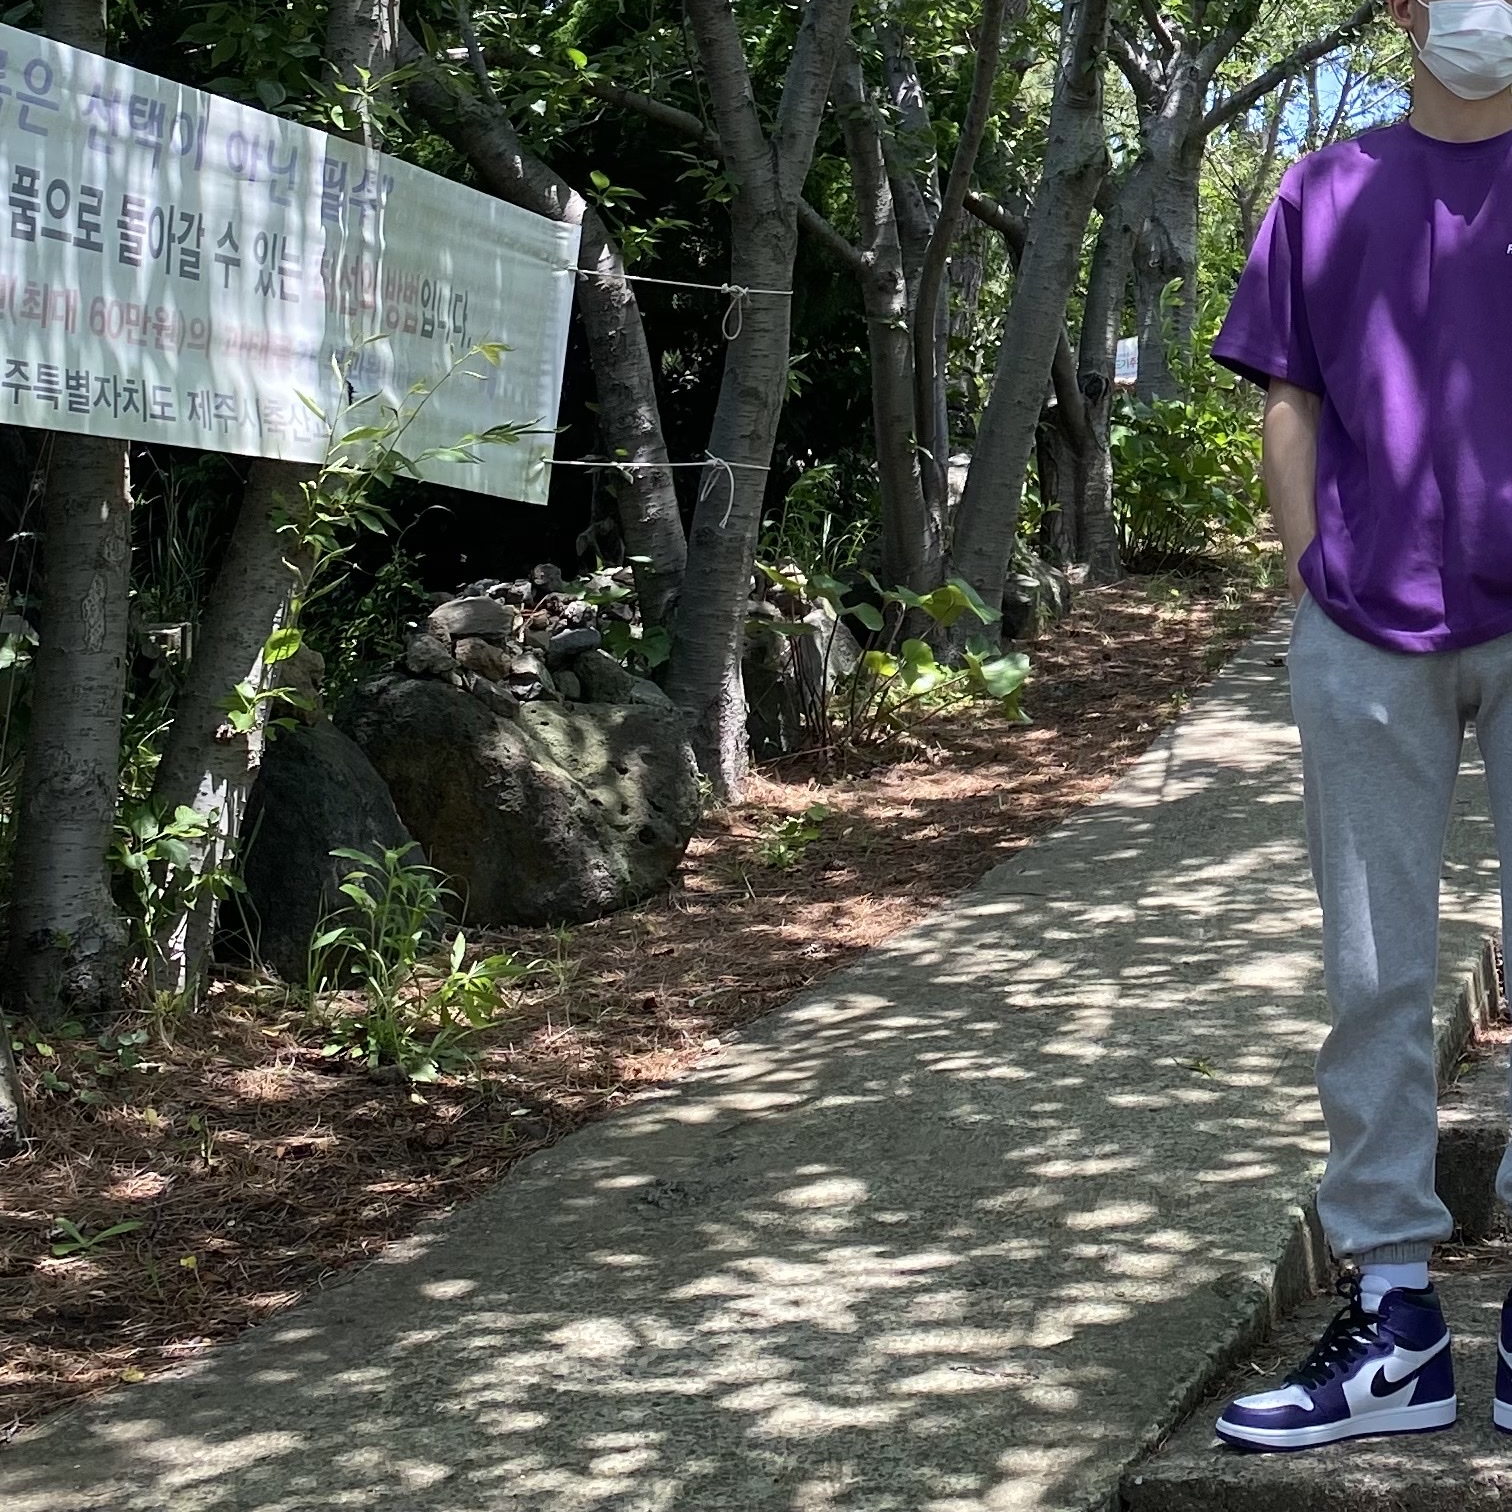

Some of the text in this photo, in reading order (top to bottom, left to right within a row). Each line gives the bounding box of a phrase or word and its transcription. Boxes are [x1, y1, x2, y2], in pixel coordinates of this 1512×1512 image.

[0, 49, 60, 137] 은
[81, 81, 209, 175] 선택이
[226, 129, 298, 208] 아닌
[8, 164, 104, 253] 품으로
[117, 193, 206, 282] 돌아갈
[214, 220, 241, 289] 수
[253, 231, 303, 304] 있는
[0, 273, 80, 335] (최대
[88, 295, 213, 361] 60만원)의
[1, 357, 177, 423] 주특별자치도
